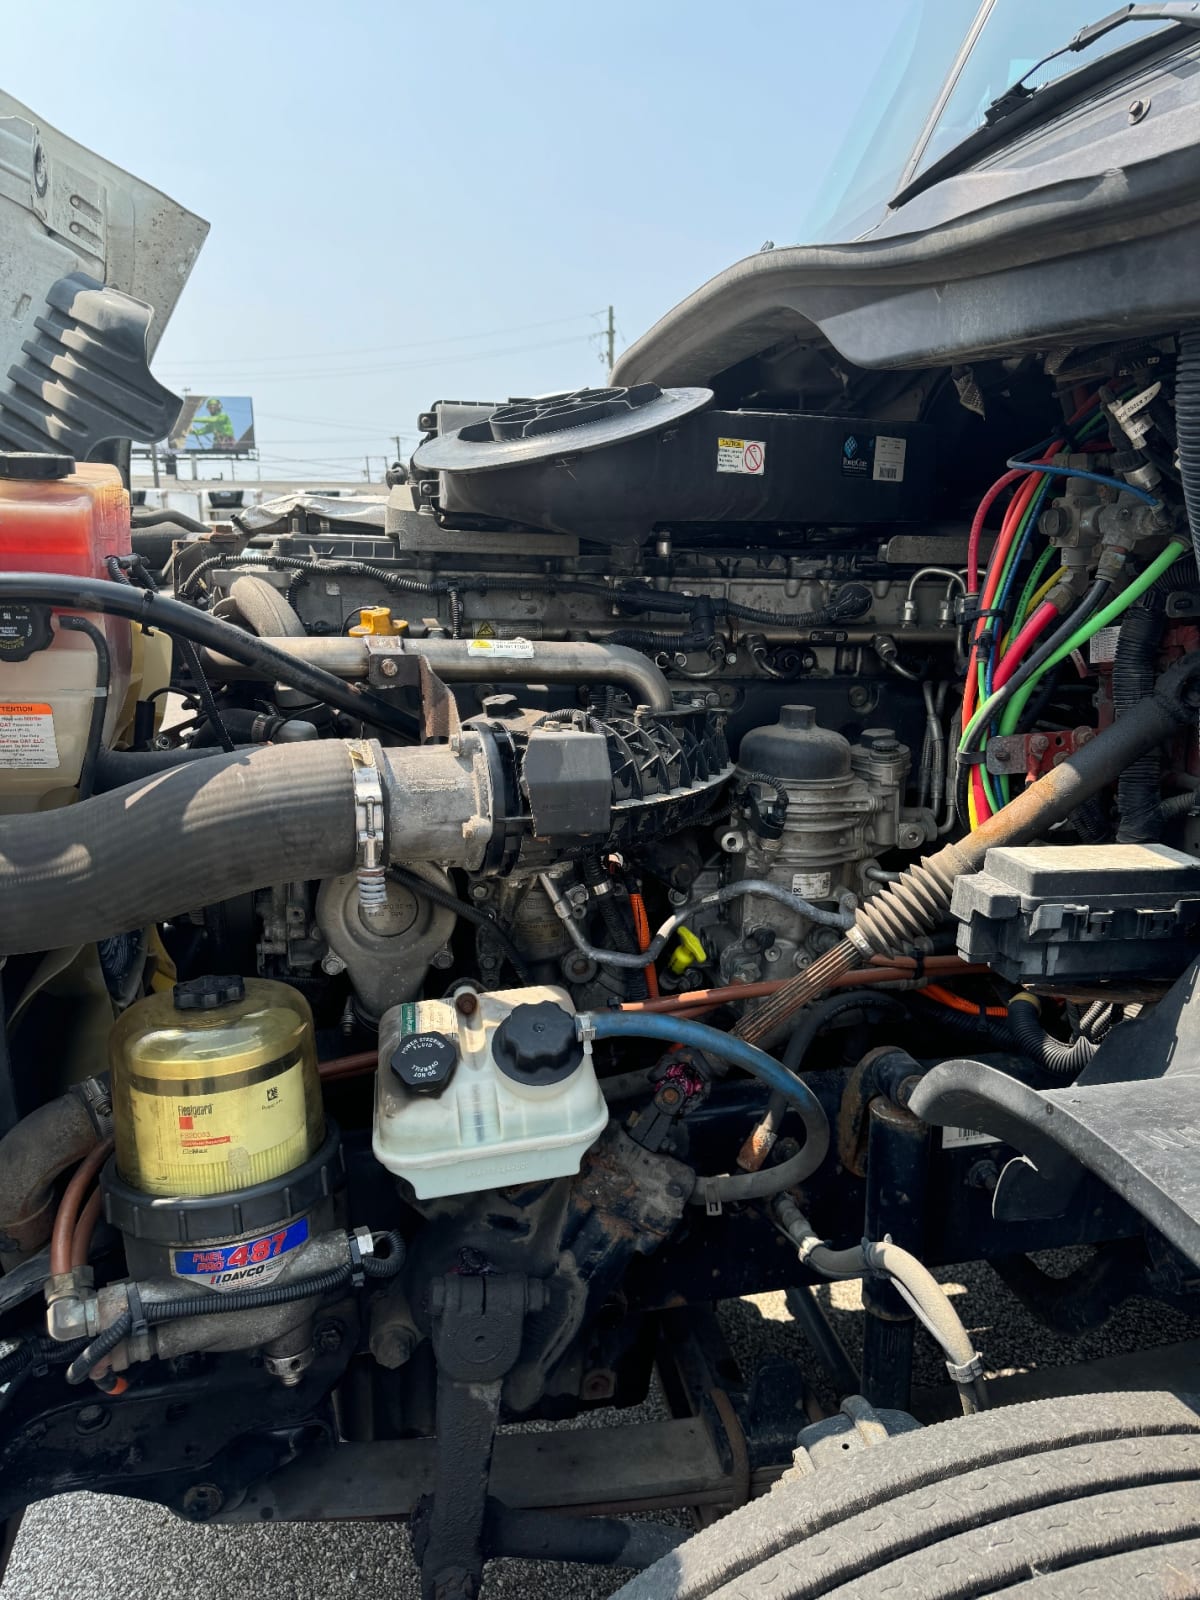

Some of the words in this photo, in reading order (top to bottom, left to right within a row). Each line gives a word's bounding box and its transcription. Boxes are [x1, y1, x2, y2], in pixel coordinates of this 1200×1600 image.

[401, 1039, 418, 1054] POWER
[420, 1037, 445, 1048] STEERING
[412, 1042, 433, 1050] FLUID
[411, 1060, 439, 1072] OVERFILL
[427, 1069, 437, 1077] DO
[226, 1231, 288, 1267] 487
[192, 1250, 224, 1263] FUEL
[196, 1261, 224, 1273] PRO
[221, 1265, 265, 1282] DAVCO
